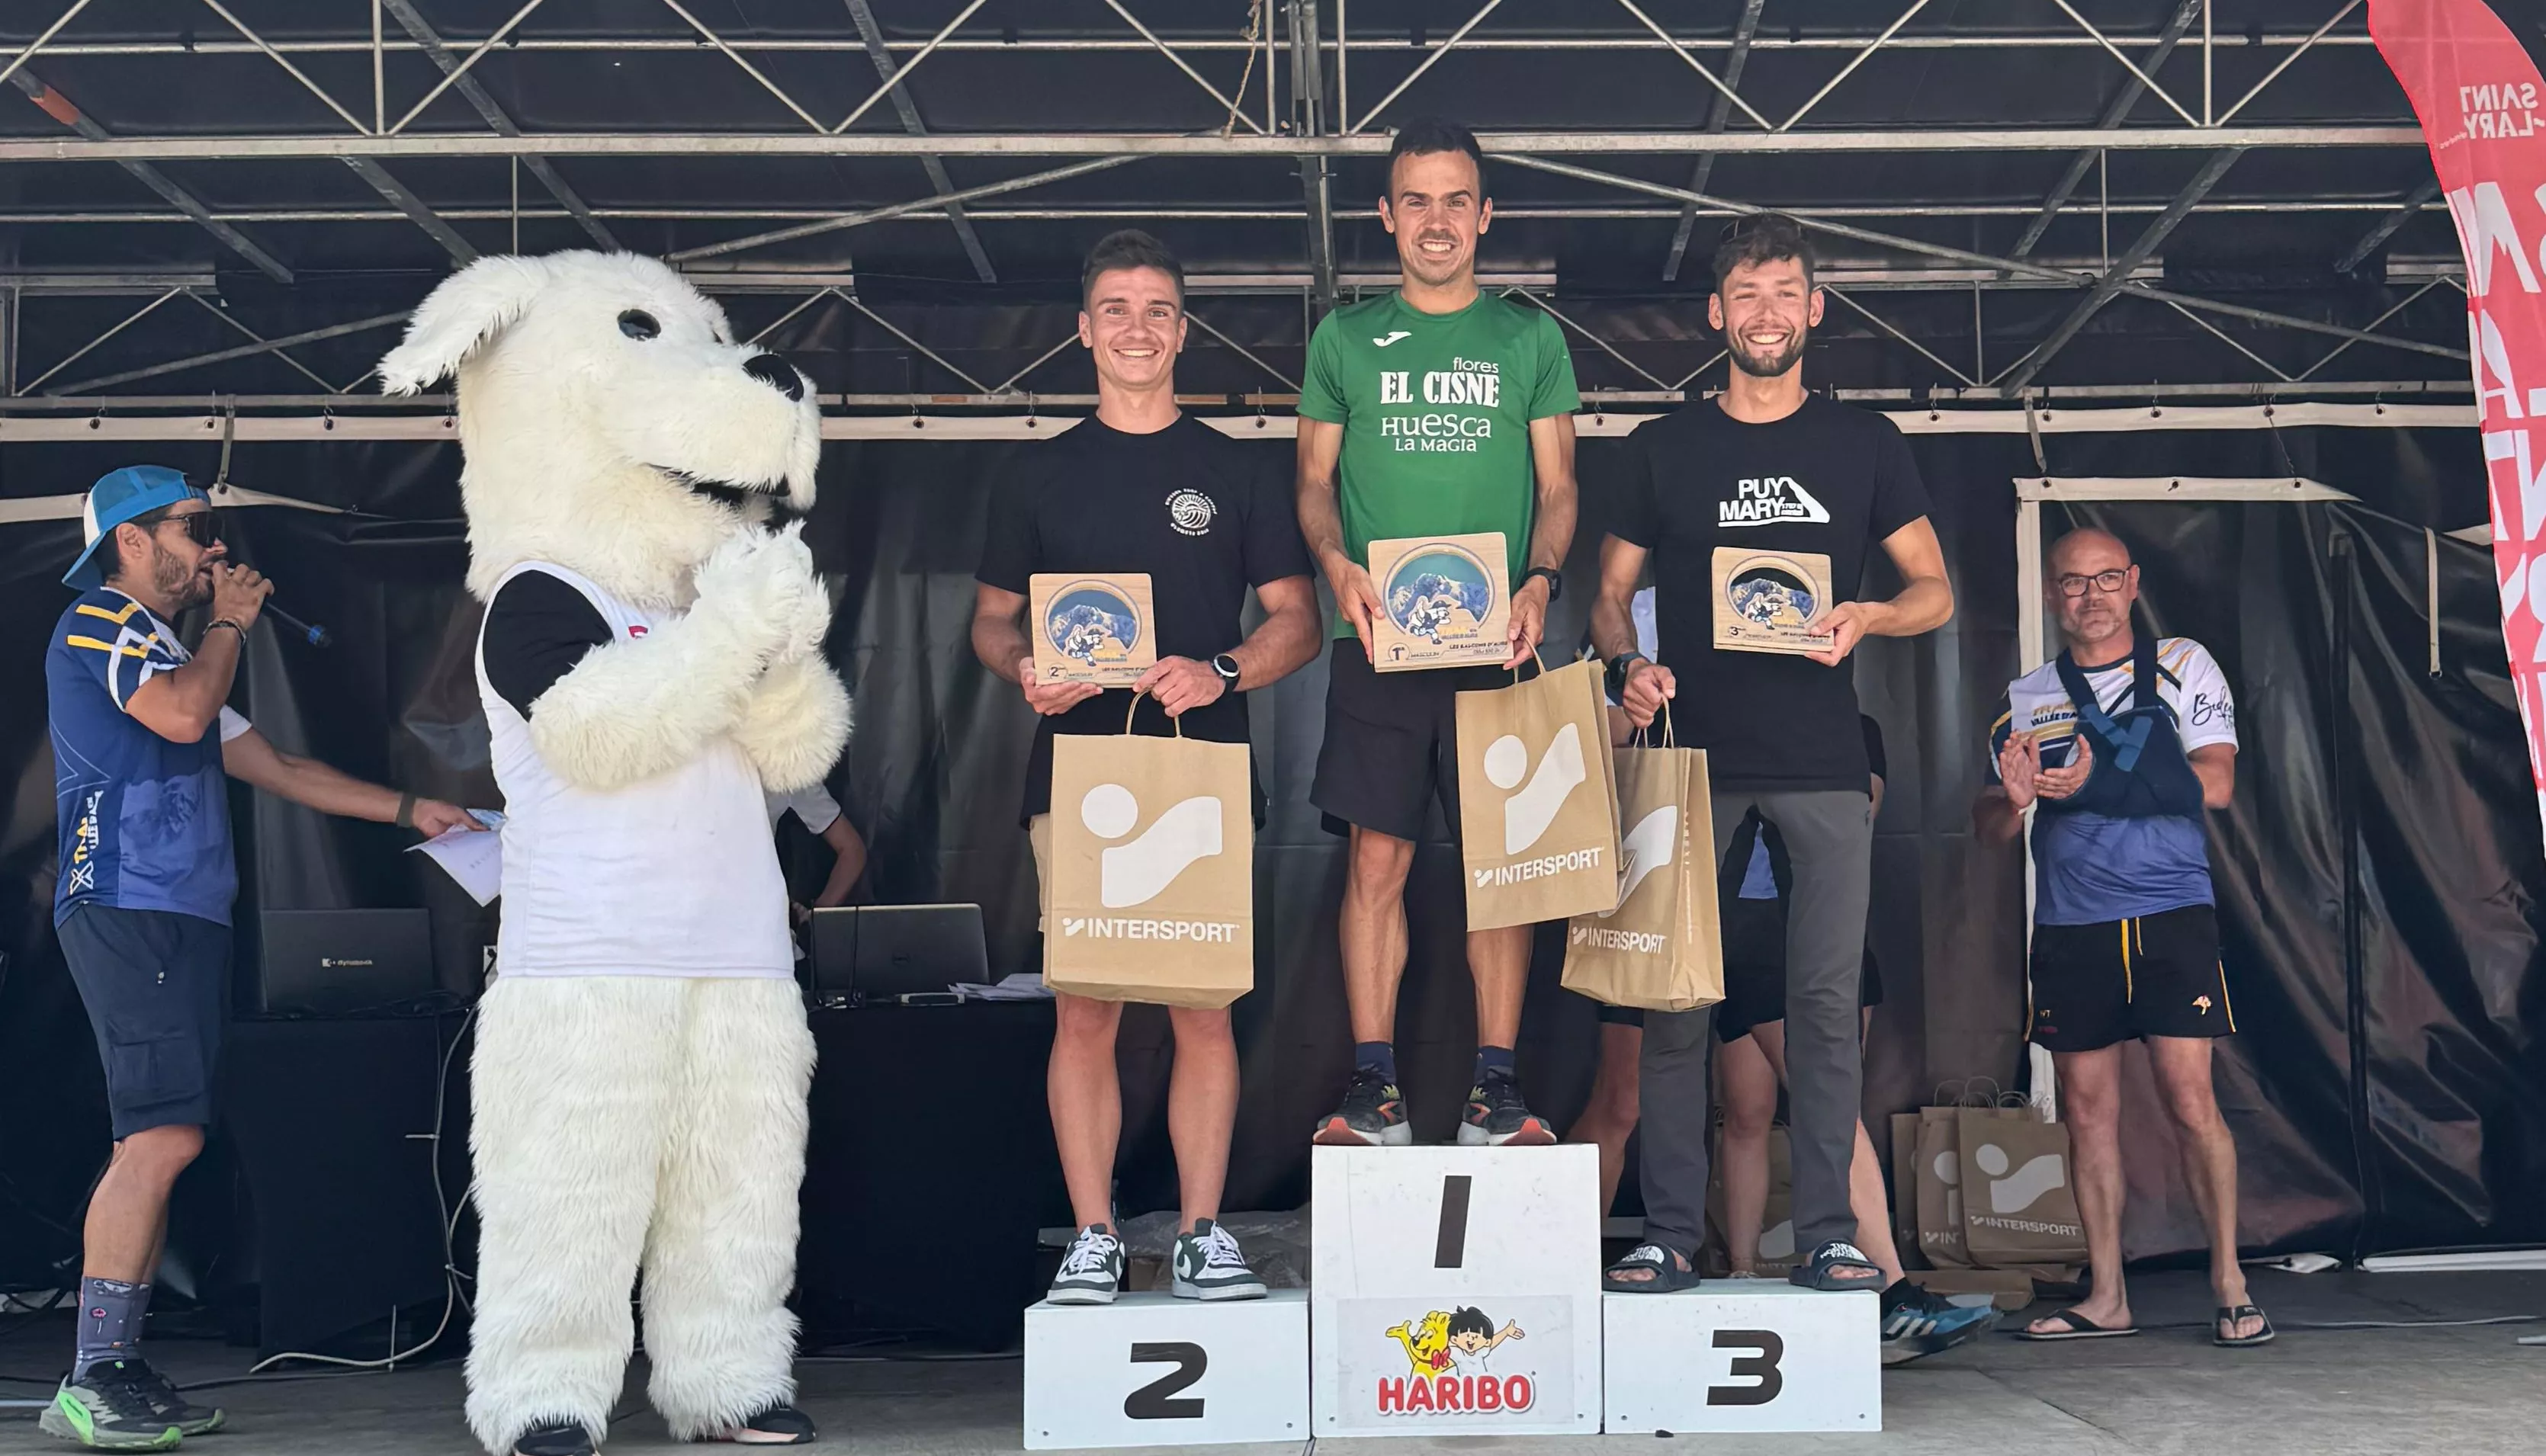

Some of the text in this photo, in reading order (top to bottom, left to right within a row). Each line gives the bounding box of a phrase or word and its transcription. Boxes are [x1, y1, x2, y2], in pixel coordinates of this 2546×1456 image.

[1453, 357, 1499, 374] flores
[1380, 370, 1501, 408] EL CISNE
[1738, 477, 1784, 499] PUY
[1719, 496, 1786, 521] MARY
[1495, 846, 1603, 887] INTERSPORT
[1087, 917, 1234, 944] INTERSPORT
[1587, 926, 1665, 954] INTERSPORT
[1985, 1216, 2080, 1237] INTERSPORT
[1123, 1341, 1209, 1420] 2
[1706, 1329, 1783, 1406] 3
[1378, 1374, 1532, 1412] HARIBO
